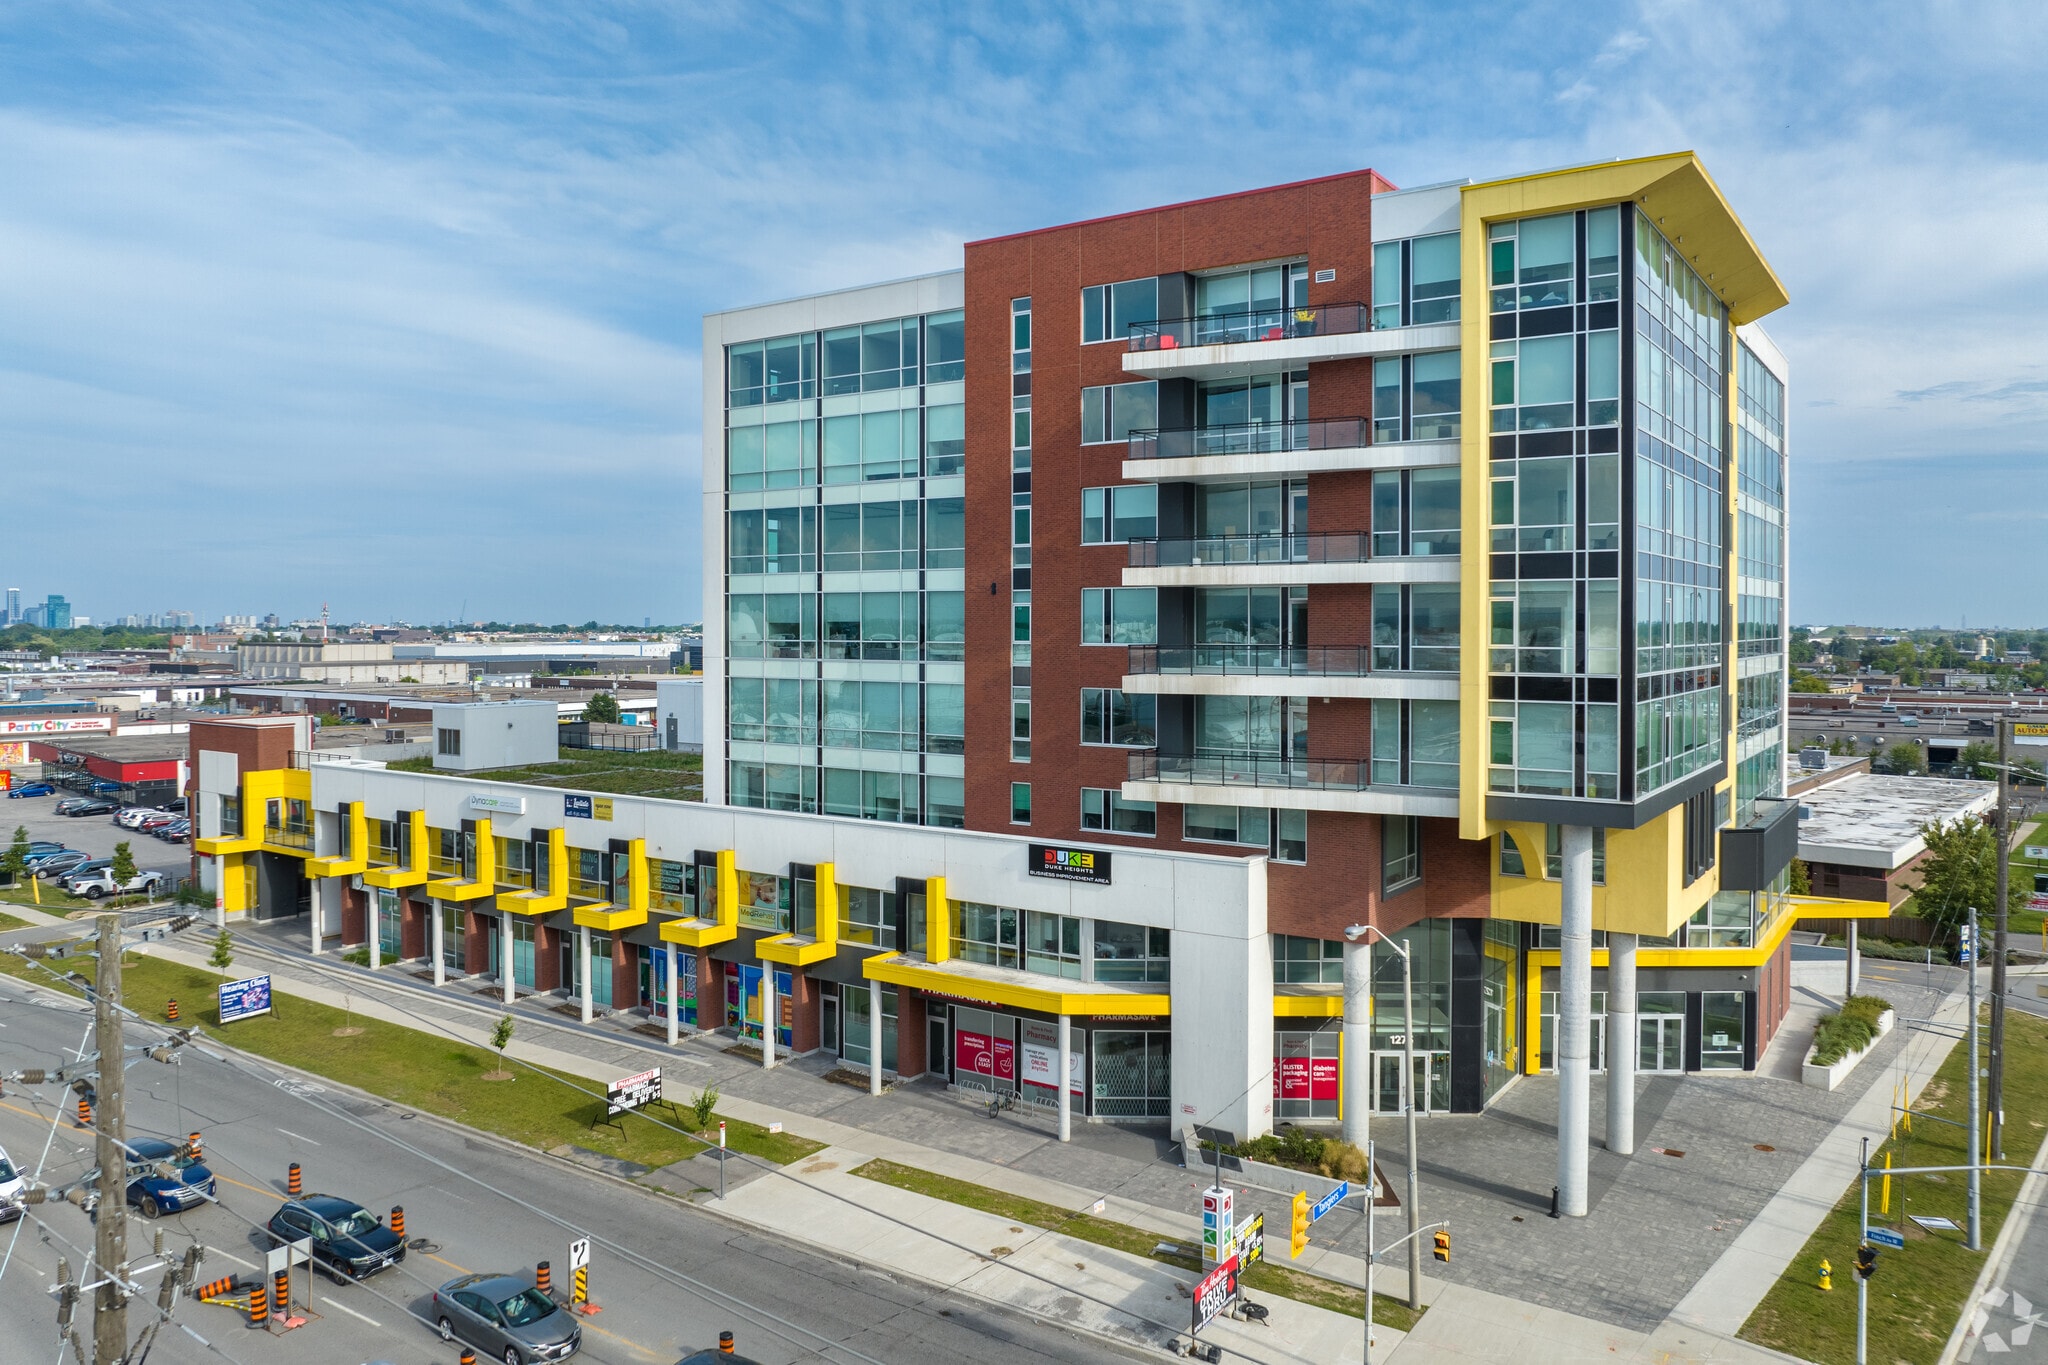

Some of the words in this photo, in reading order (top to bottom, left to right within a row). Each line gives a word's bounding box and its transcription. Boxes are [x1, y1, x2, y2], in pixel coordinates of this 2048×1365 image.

[8, 722, 43, 732] Party
[44, 720, 68, 730] City
[571, 849, 598, 864] HEARING
[1044, 849, 1094, 868] DUKE
[574, 864, 594, 875] CLINIC
[1029, 870, 1055, 878] BUSINESS
[1055, 872, 1094, 882] IMPROVEMENT
[1064, 866, 1094, 874] HEIGHTS
[740, 908, 776, 920] MedRehab
[221, 982, 249, 994] Hearing
[250, 976, 269, 988] Clinic
[1026, 1030, 1056, 1043] Pharmacy
[1390, 1035, 1414, 1045] 127
[617, 1071, 653, 1089] PHARMASAVE
[614, 1095, 627, 1105] FREE
[632, 1084, 655, 1099] DELIVERY
[622, 1081, 649, 1096] PHARMACY
[1204, 1196, 1217, 1261] DUKE
[1200, 1276, 1228, 1311] DRIVE
[1201, 1289, 1227, 1320] THRU
